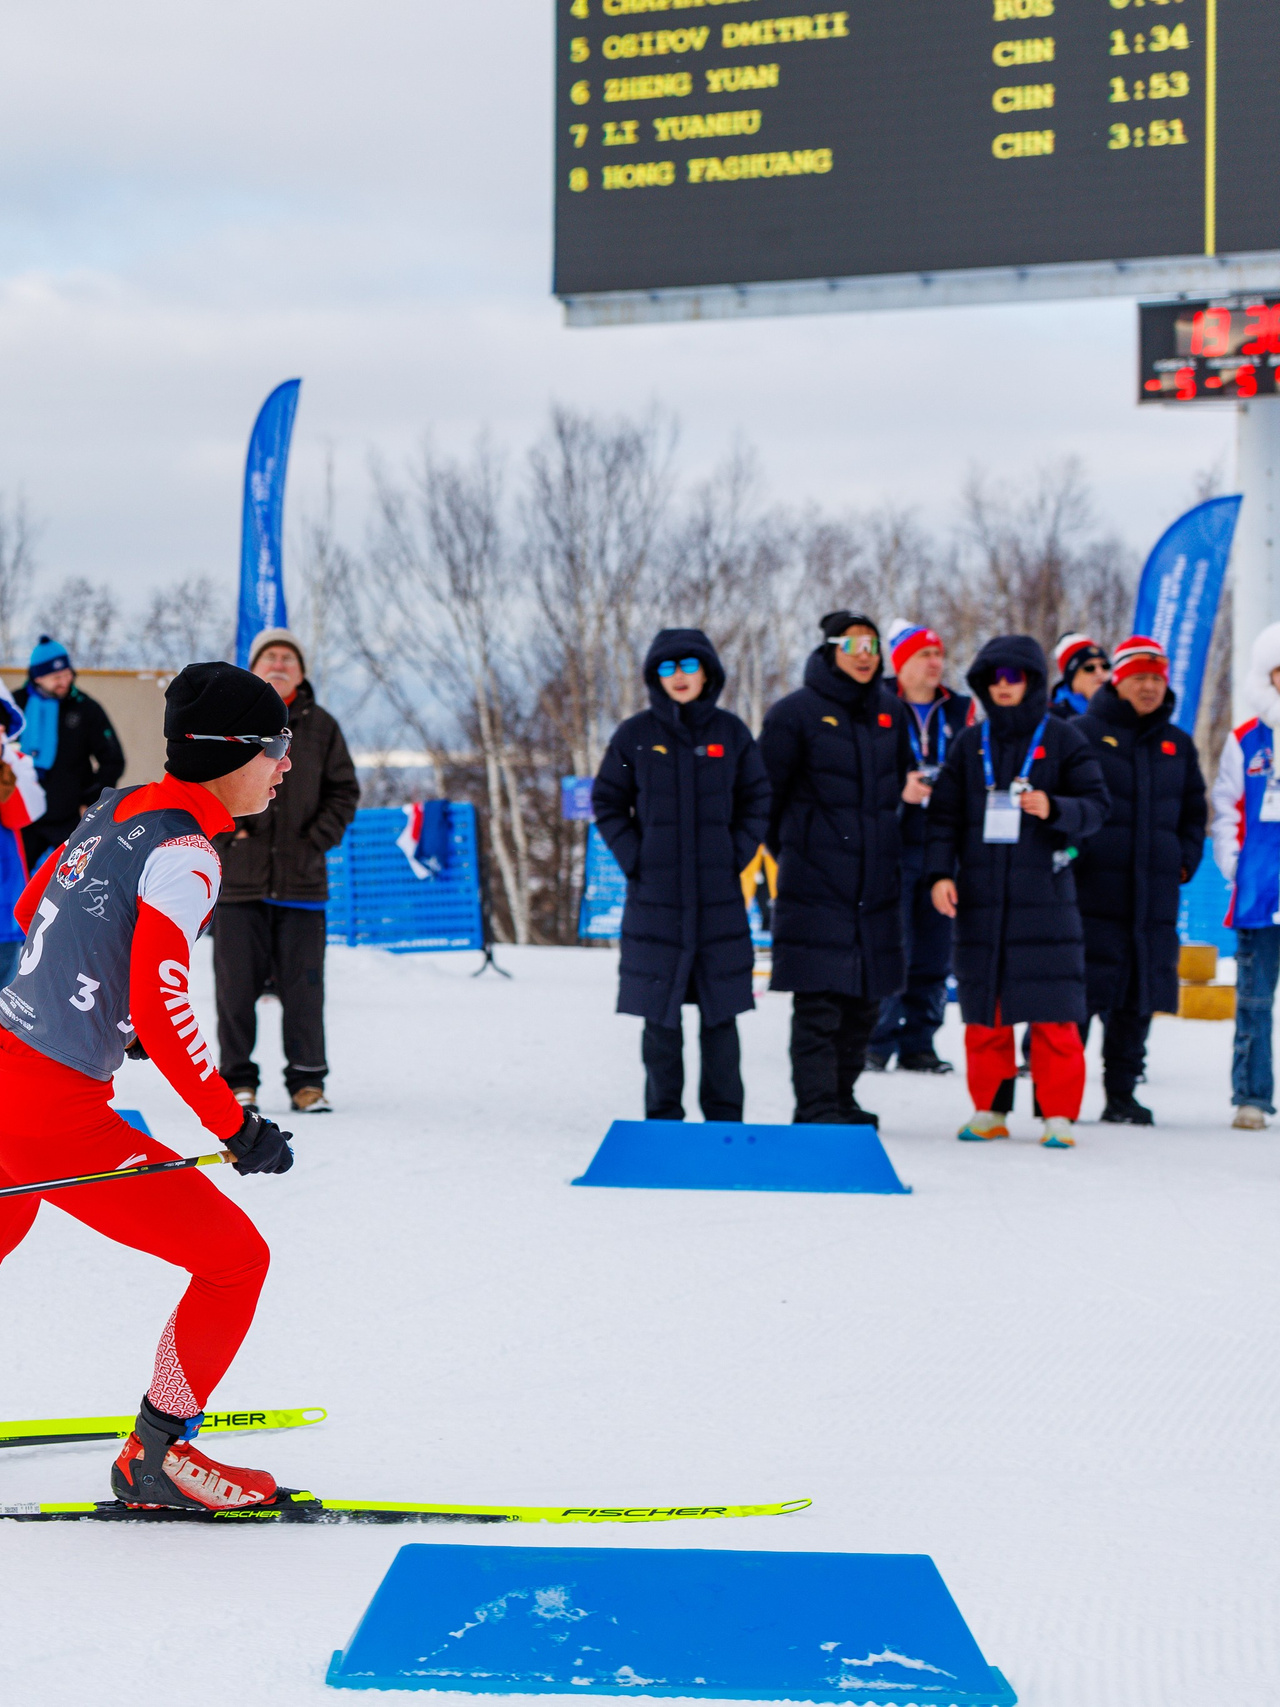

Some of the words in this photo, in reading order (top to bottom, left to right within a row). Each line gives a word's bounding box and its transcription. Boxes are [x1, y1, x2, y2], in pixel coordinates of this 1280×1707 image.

[570, 37, 590, 62] 5
[602, 26, 710, 60] OSIPOV
[722, 11, 849, 48] DMITRII
[570, 80, 590, 105] 6
[604, 72, 692, 102] ZHENG
[705, 63, 780, 93] YUAN
[992, 37, 1055, 67] CHN
[1108, 22, 1189, 56] 1:34
[569, 123, 589, 148] 7
[602, 120, 639, 146] LI
[653, 109, 762, 142] YUANHU
[992, 83, 1055, 113] CHN
[1108, 71, 1190, 103] 1:53
[569, 167, 589, 192] 8
[602, 161, 675, 190] HONG
[687, 148, 833, 183] FASHUANG
[992, 129, 1055, 159] CHN
[1107, 118, 1189, 149] 3:51
[69, 972, 100, 1011] 3
[202, 1412, 267, 1428] CHER
[213, 1510, 281, 1518] FISCHER
[561, 1507, 727, 1517] FISCHER
